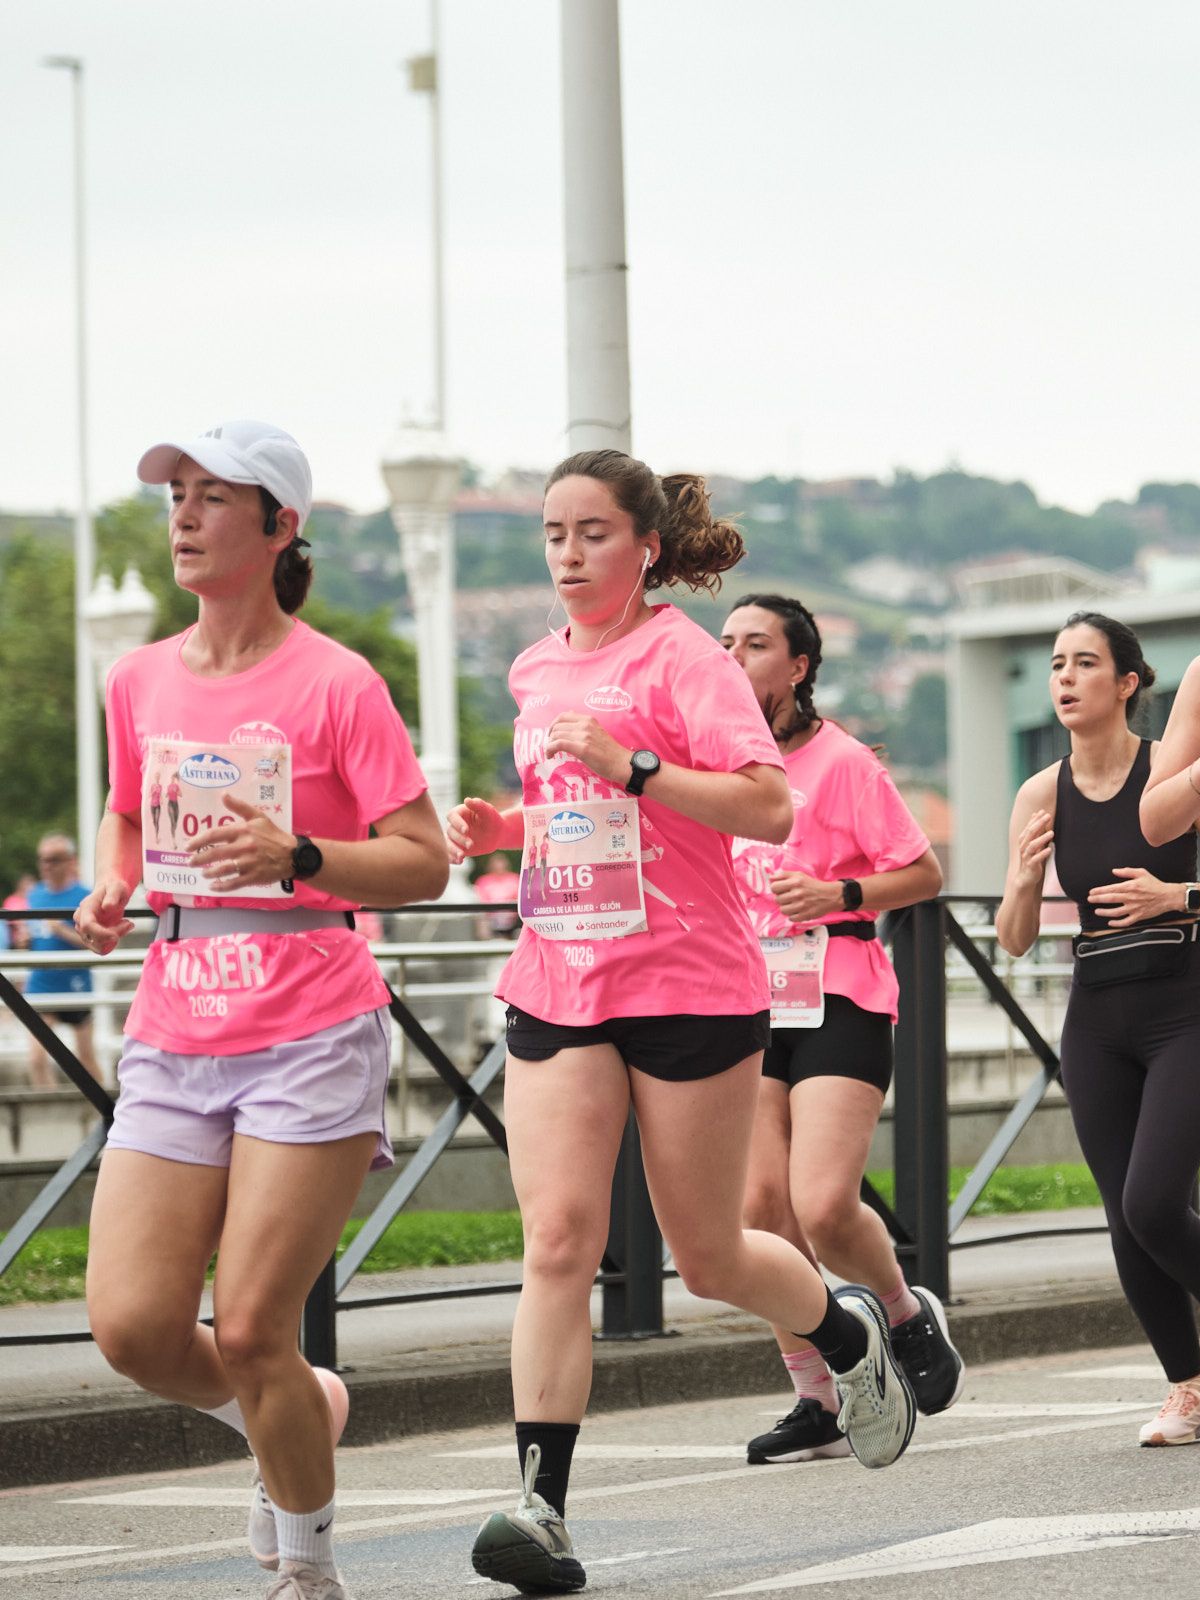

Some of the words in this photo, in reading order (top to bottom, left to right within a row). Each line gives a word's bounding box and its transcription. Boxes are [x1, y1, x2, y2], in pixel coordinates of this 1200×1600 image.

[588, 694, 629, 707] ASTURIANA
[183, 765, 235, 781] ASTURIANA
[551, 825, 591, 836] ASTURIANA
[595, 863, 636, 872] CORREDORA
[156, 871, 197, 886] OYSHO
[548, 865, 594, 890] 016
[563, 893, 579, 903] 315
[533, 905, 556, 916] CARRERA
[556, 904, 565, 914] DE
[564, 904, 573, 913] LA
[572, 903, 594, 913] MUJER
[600, 901, 621, 910] GIJÓN
[533, 922, 564, 933] OYSHO
[585, 920, 629, 931] Santander
[564, 945, 595, 967] 2026
[188, 994, 228, 1018] 2026
